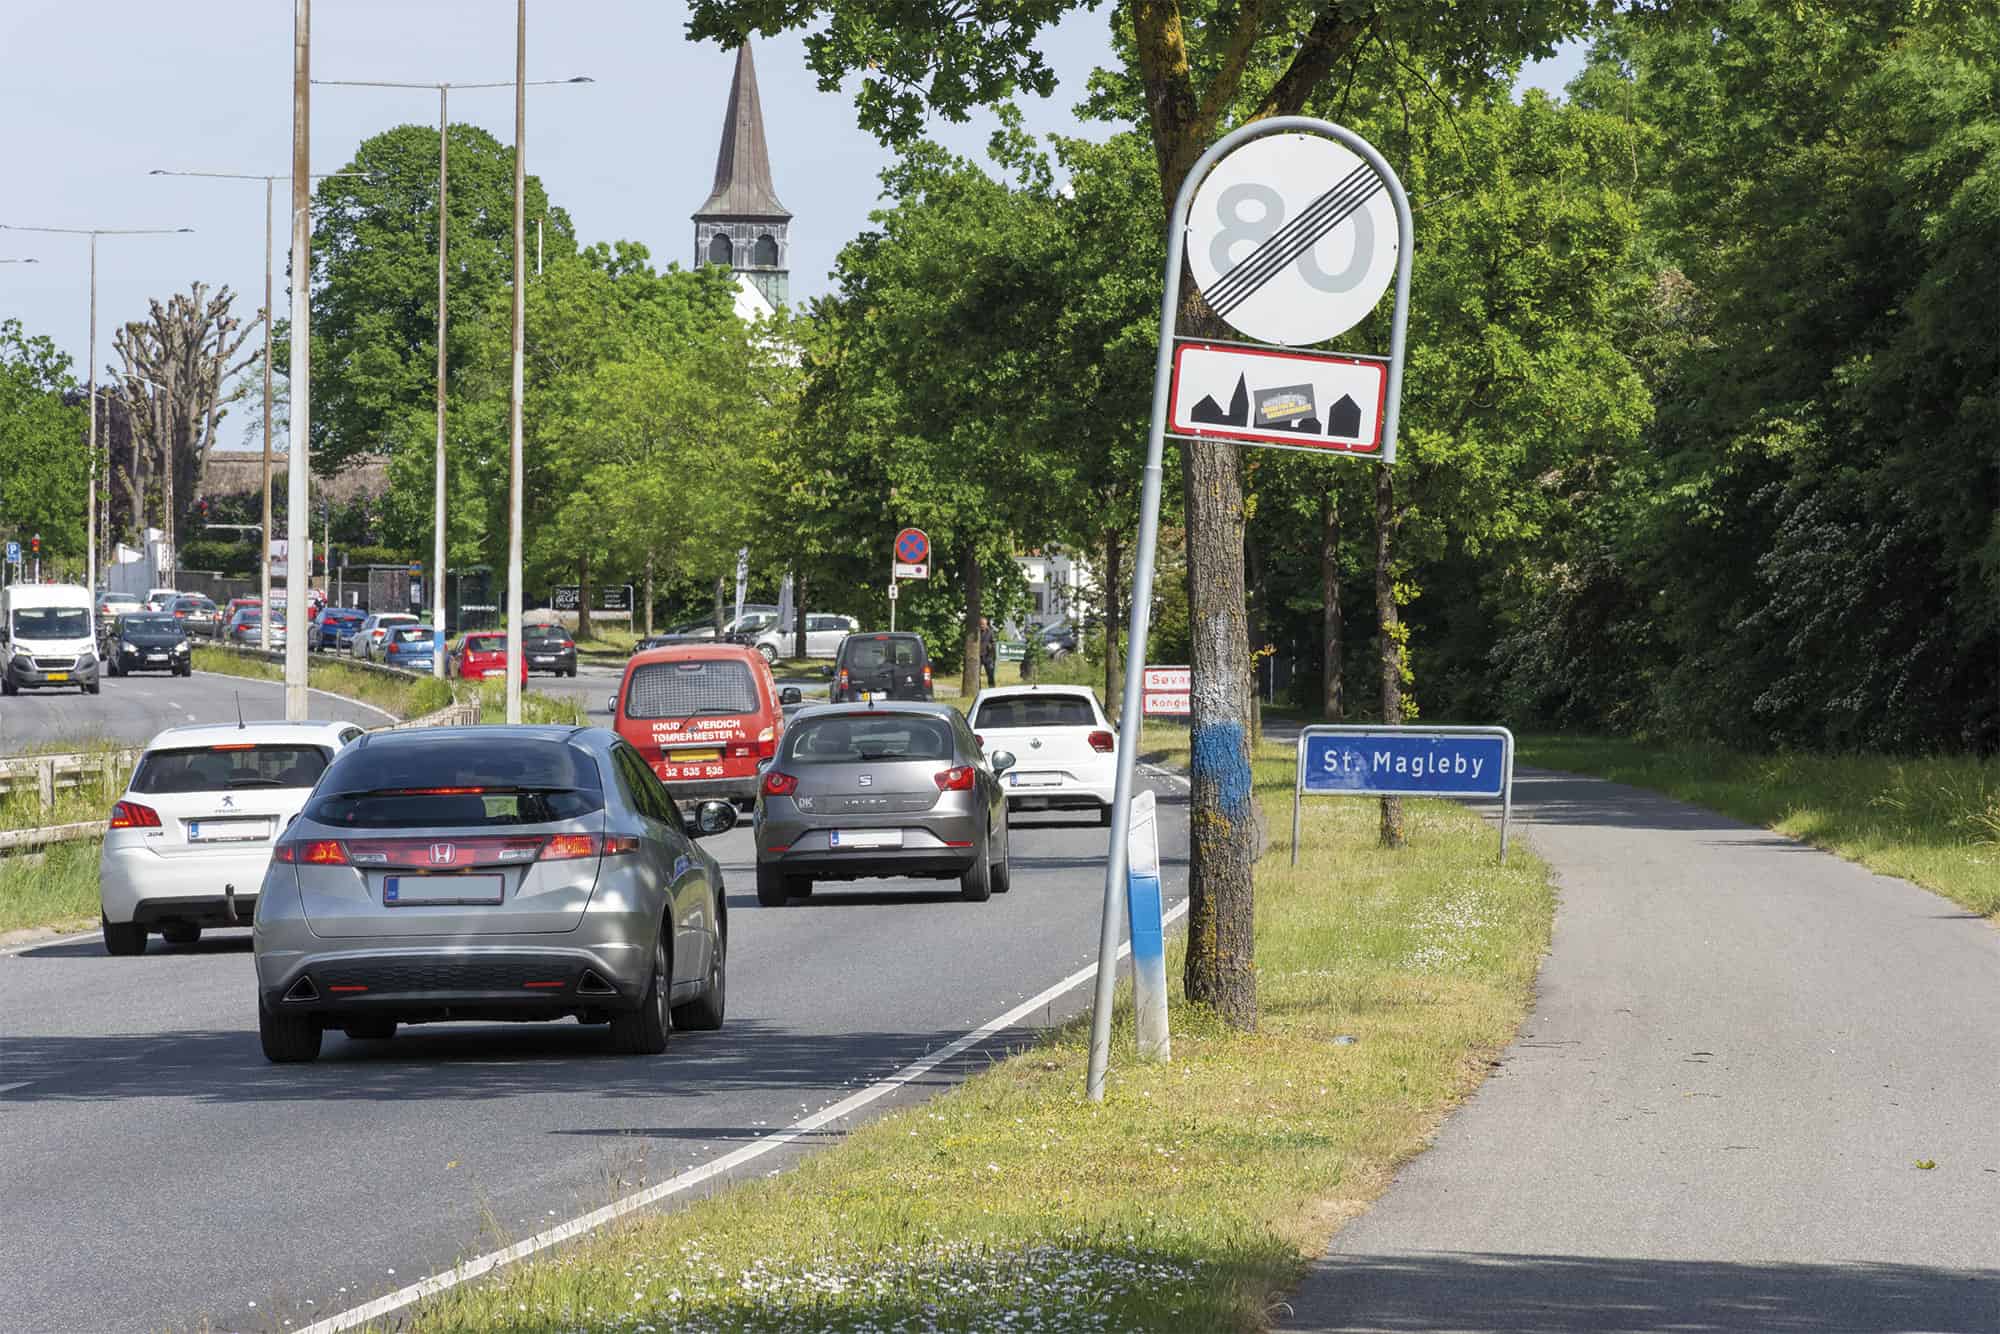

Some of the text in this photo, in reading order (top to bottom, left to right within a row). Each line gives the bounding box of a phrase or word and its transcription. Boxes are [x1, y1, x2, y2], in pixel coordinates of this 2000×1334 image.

[1209, 183, 1375, 294] 80
[652, 719, 741, 731] KNUD VERDICH
[666, 766, 724, 777] 32 535 535
[1323, 750, 1484, 778] St. Magleby
